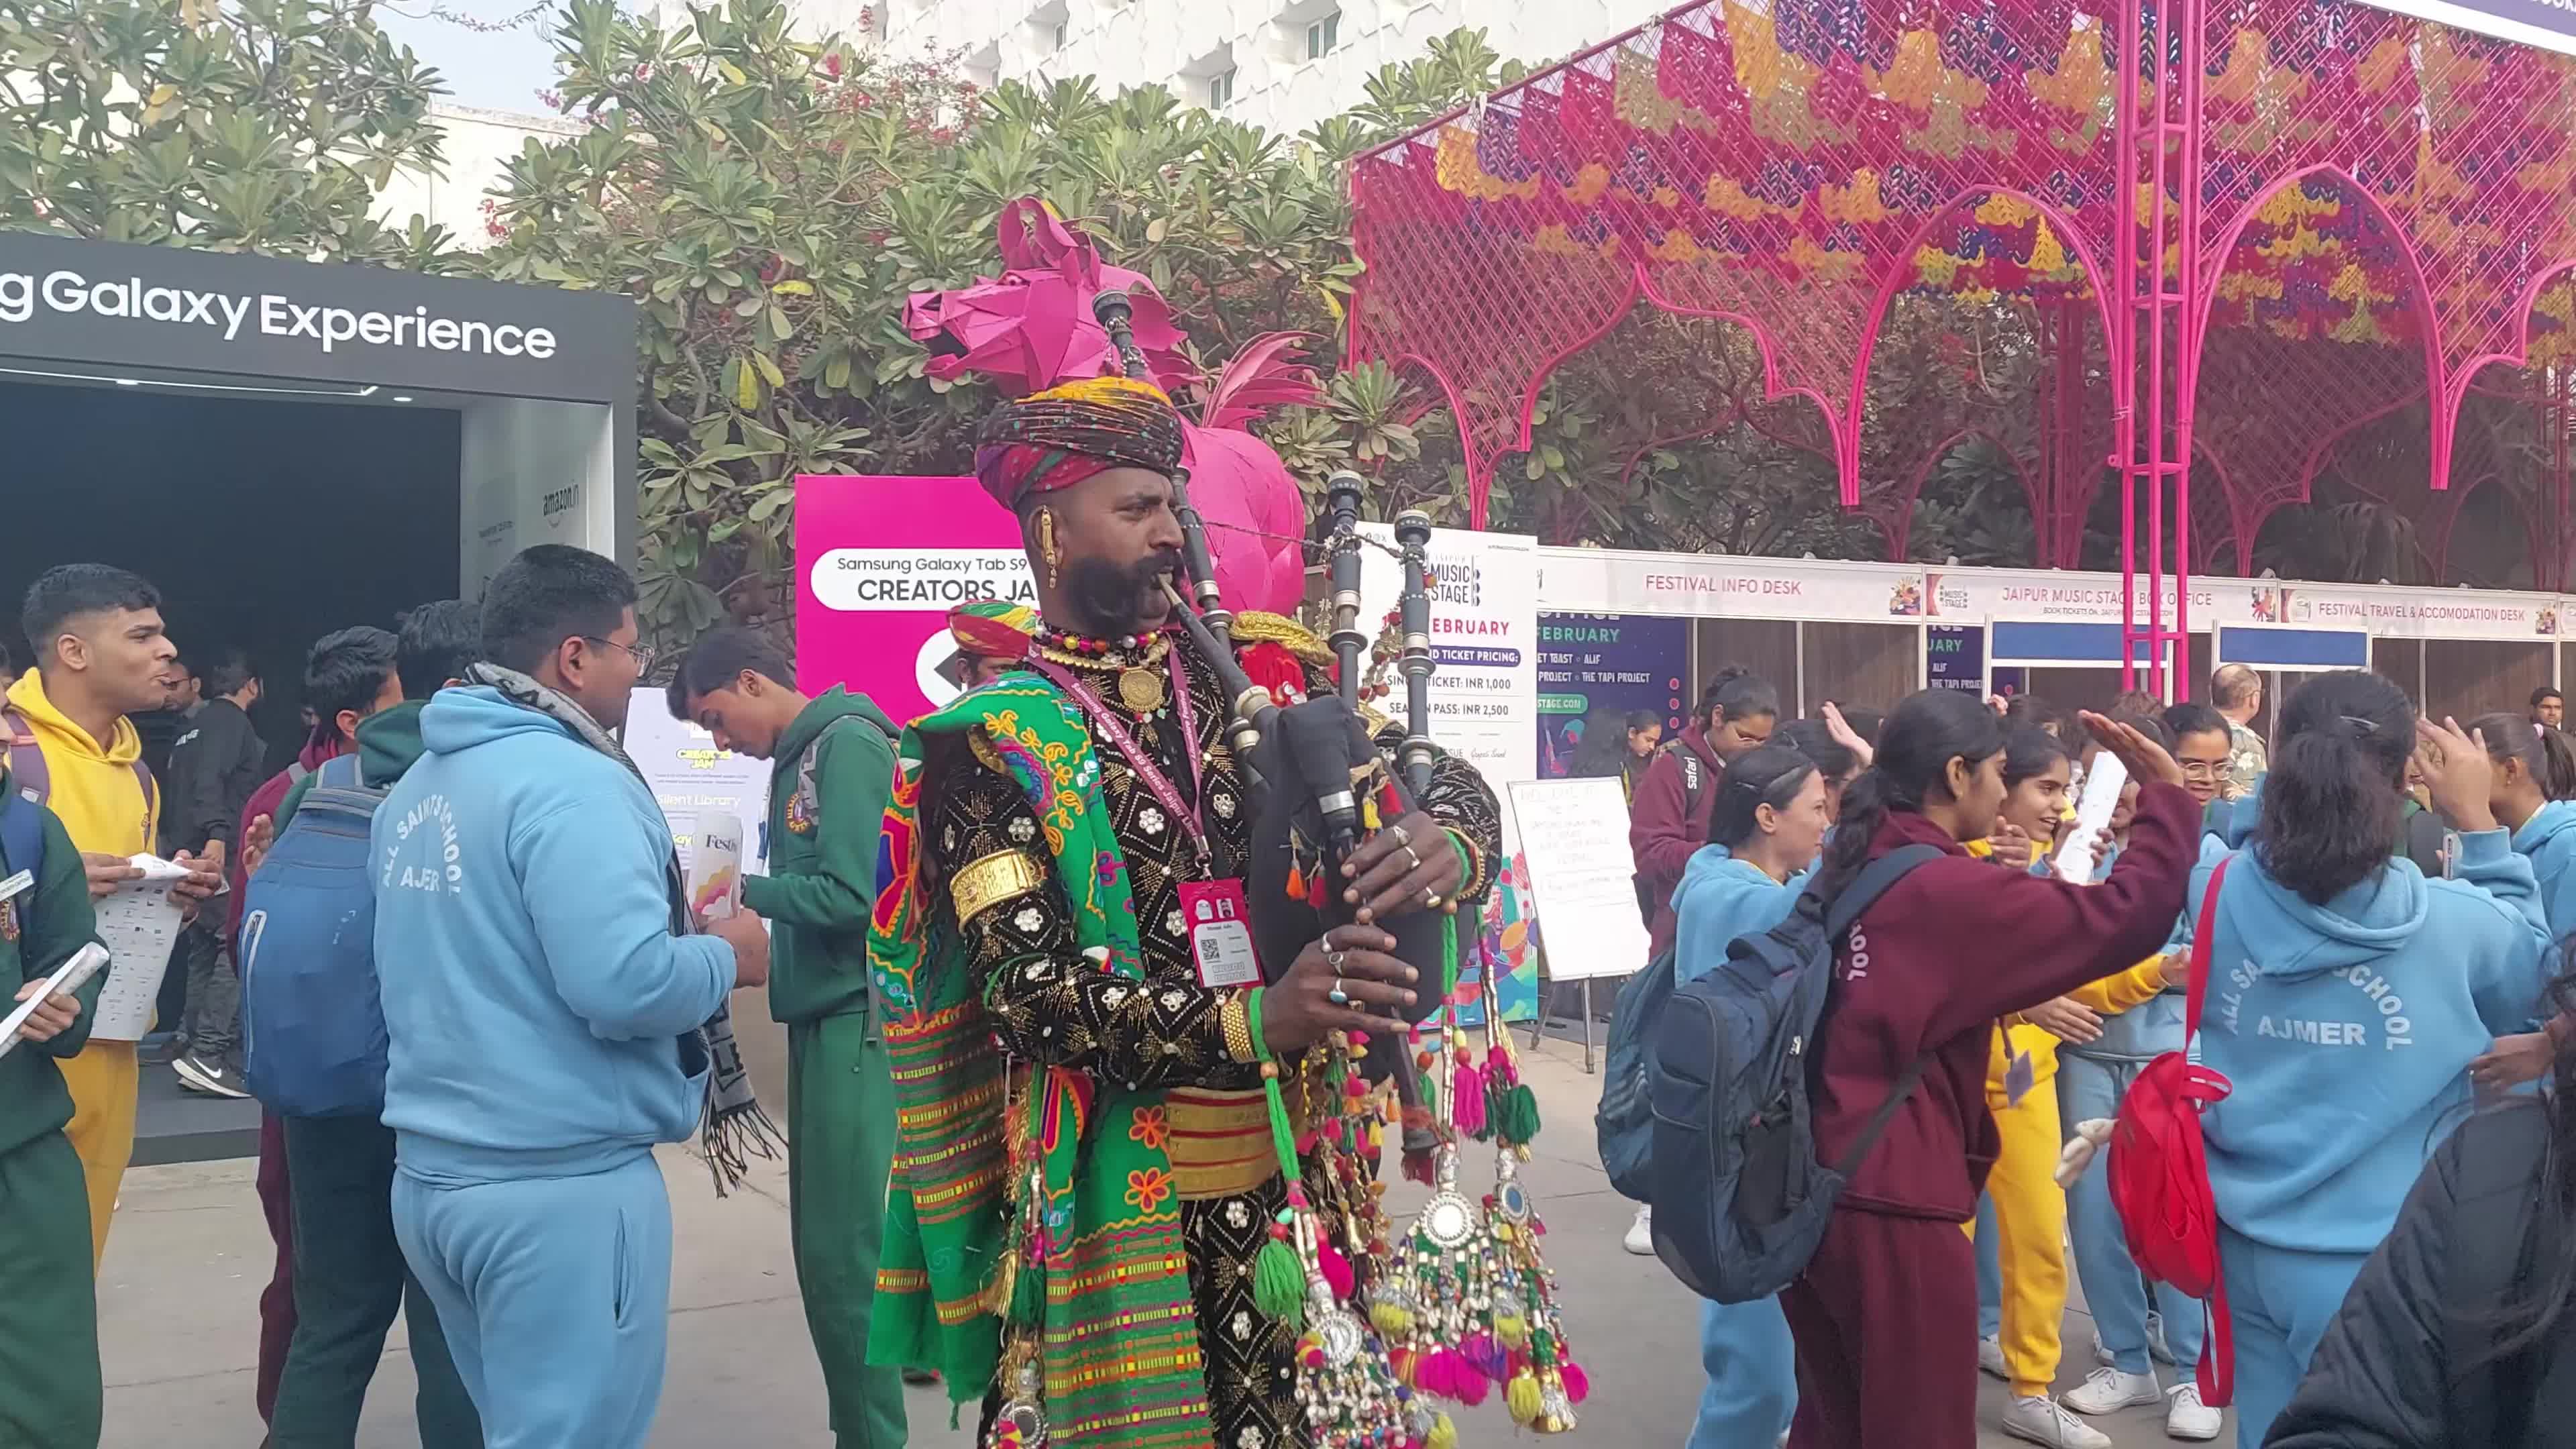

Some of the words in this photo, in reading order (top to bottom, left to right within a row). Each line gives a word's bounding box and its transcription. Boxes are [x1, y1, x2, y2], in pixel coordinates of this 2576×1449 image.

[42, 270, 252, 341] Galaxy
[260, 294, 557, 358] Experience
[838, 558, 912, 574] Samsung
[915, 558, 971, 574] Galaxy
[975, 558, 1006, 570] Tab
[1010, 558, 1027, 570] S9
[1430, 564, 1470, 582] MUSIC
[857, 579, 996, 600] CREATORS
[1005, 580, 1036, 600] JA
[1431, 584, 1469, 604] STAGE
[1646, 575, 1717, 592] FESTIVAL
[1722, 579, 1758, 593] INFO
[1763, 580, 1802, 595] DESK
[2002, 587, 2047, 602] JAIPUR
[2052, 589, 2092, 603] MUSIC
[2096, 590, 2124, 604] STAG
[2167, 592, 2212, 606] OFICE
[2318, 602, 2367, 616] FESTIVAL
[2370, 604, 2407, 618] TRAVEL
[2410, 606, 2416, 619] &
[2418, 606, 2497, 621] ACCOMODATION
[2500, 608, 2525, 622] DESK
[1432, 618, 1509, 635] EBRUARY
[1442, 649, 1475, 661] TICKET
[1477, 651, 1519, 662] PRICING:
[1584, 654, 1601, 664] ALIF
[1427, 676, 1463, 688] TICKET:
[1466, 678, 1483, 689] INR
[1486, 679, 1511, 692] 1,000
[1538, 672, 1572, 682] PROJECT
[1582, 672, 1596, 682] THE
[1597, 672, 1615, 682] TAPI
[1617, 672, 1650, 683] PROJECT
[1389, 702, 1430, 714] SEAN
[1434, 704, 1460, 714] PASS:
[1463, 704, 1481, 715] INR
[1483, 705, 1509, 718] 2,500
[1071, 683, 1102, 713] Samsung
[1101, 713, 1124, 738] Galaxy
[1123, 739, 1136, 754] Tab
[1143, 765, 1165, 791] Series
[1163, 792, 1184, 816] Jaipur
[1684, 756, 1697, 790] safari
[2257, 1015, 2367, 1046] AJMER
